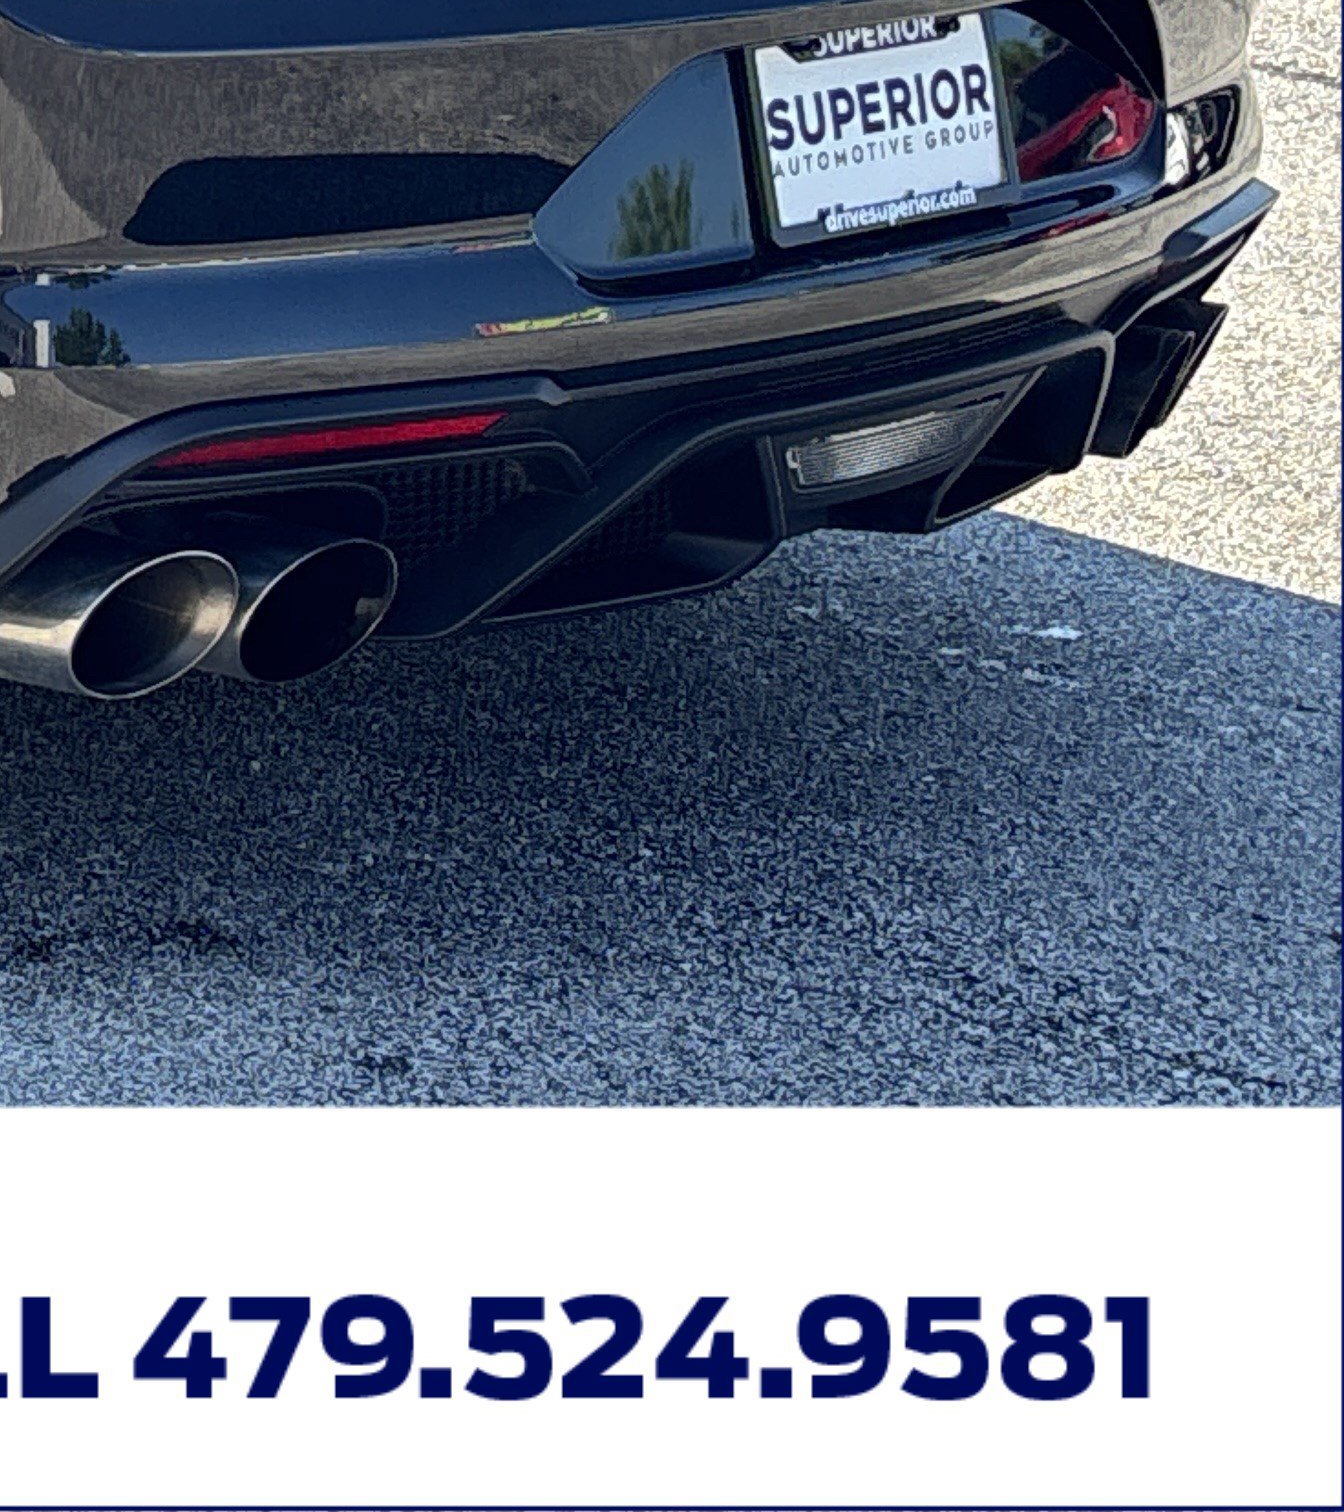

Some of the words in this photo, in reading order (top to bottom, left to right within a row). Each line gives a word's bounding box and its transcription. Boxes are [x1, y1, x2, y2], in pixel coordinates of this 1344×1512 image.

[766, 63, 992, 151] SUPERIOR
[773, 134, 914, 179] AUTOMOTIVE
[924, 119, 995, 151] GROUP
[824, 187, 978, 234] drivesuperior.com
